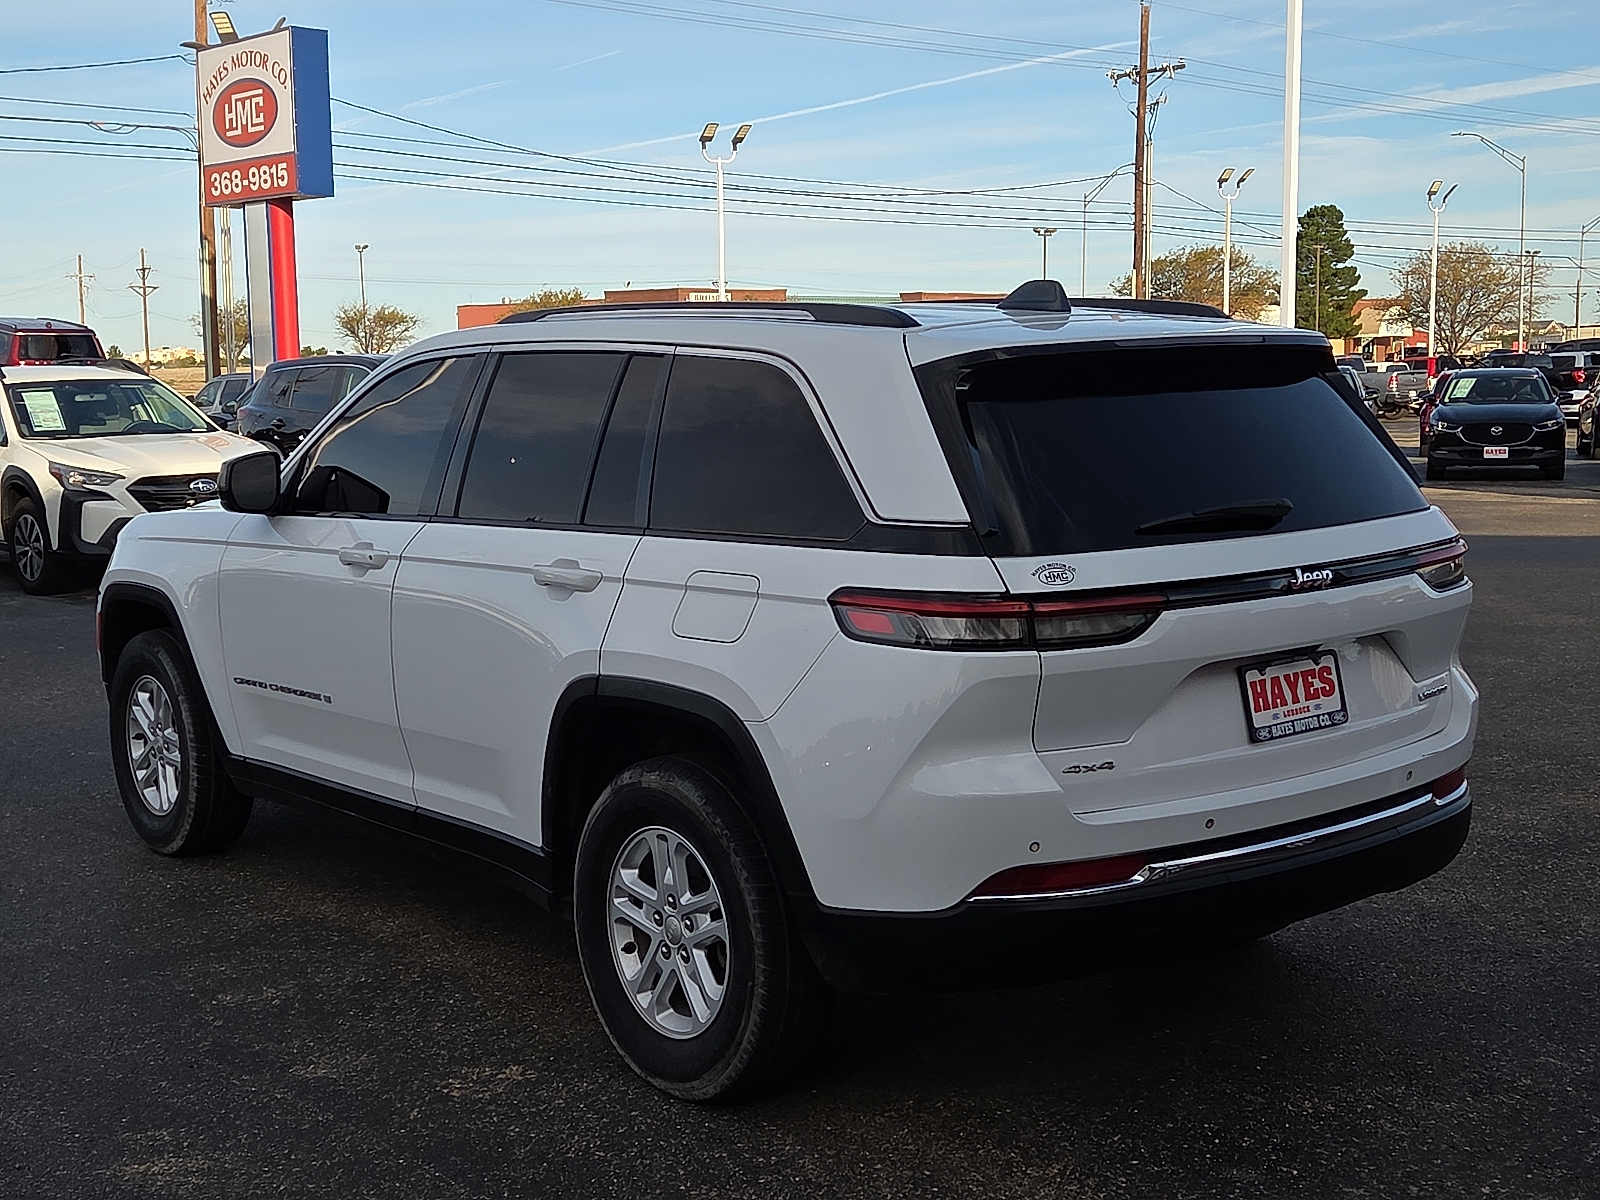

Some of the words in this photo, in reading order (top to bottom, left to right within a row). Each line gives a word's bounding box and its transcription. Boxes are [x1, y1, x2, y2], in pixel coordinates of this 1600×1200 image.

[202, 60, 230, 105] HAYES
[230, 50, 270, 73] MOTOR
[271, 61, 288, 90] CO.
[224, 88, 265, 138] HMC
[210, 162, 289, 197] 368-9815
[1044, 570, 1070, 584] HMC
[1290, 568, 1333, 585] Jeep
[1249, 665, 1336, 714] HAYES
[1271, 721, 1294, 737] HAYES
[1294, 716, 1320, 732] MOTOR
